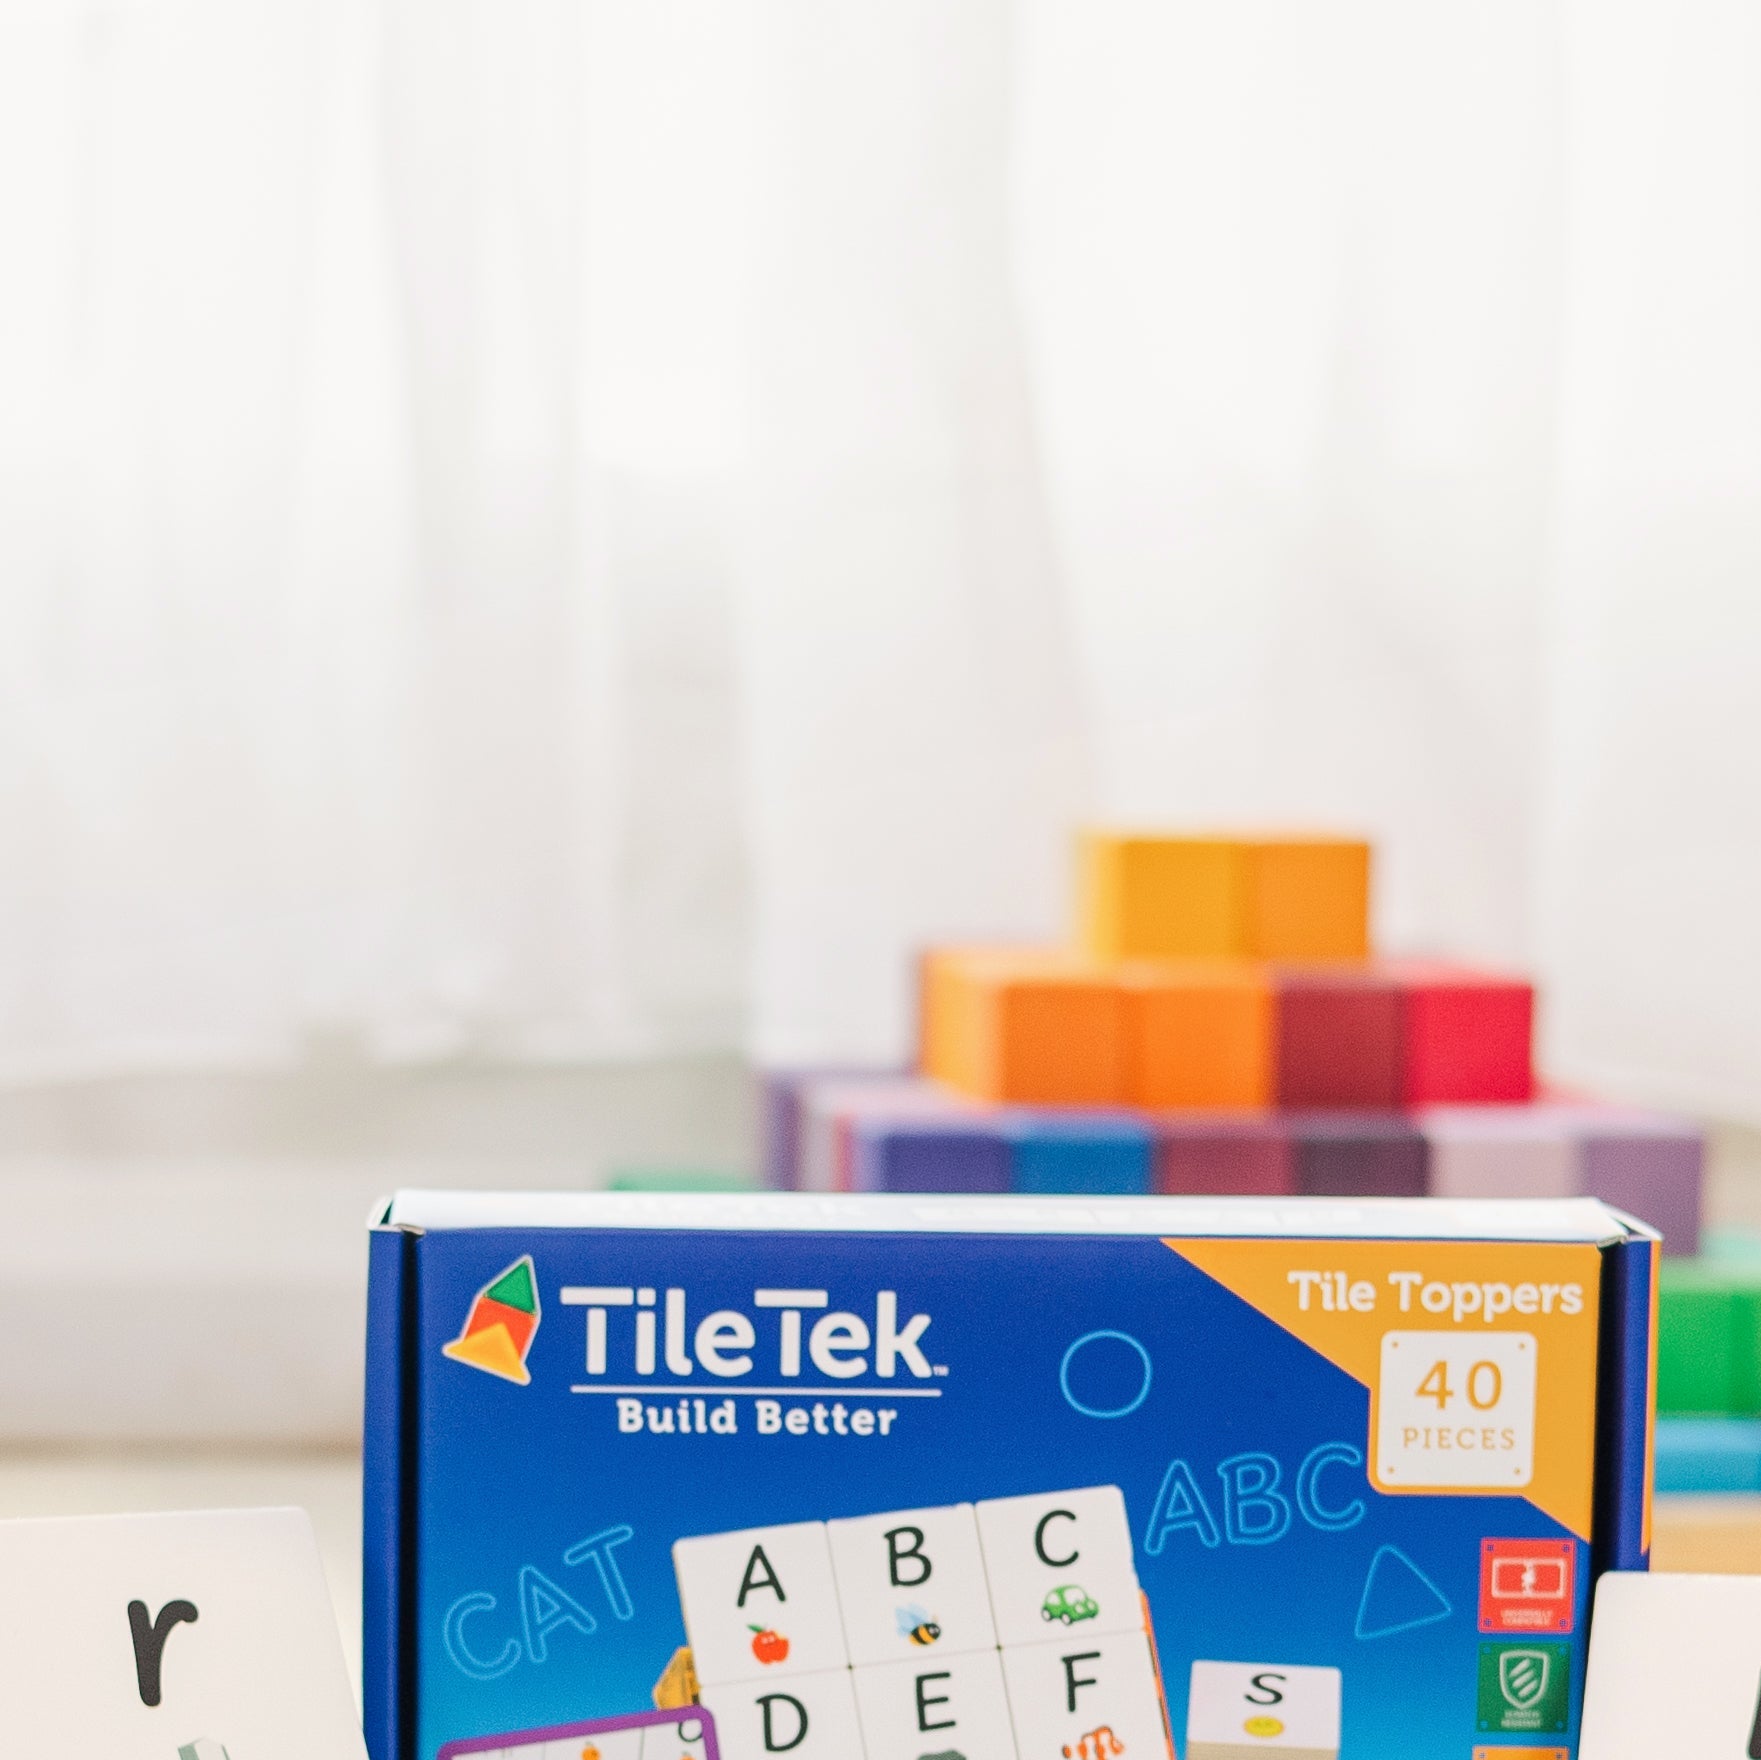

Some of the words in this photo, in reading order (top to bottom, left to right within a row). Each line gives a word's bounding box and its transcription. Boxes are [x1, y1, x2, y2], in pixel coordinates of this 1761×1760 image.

[1287, 1270, 1376, 1312] Tile
[1388, 1271, 1584, 1322] Toppers
[560, 1287, 933, 1378] TileTek
[617, 1398, 737, 1434] Build
[756, 1399, 897, 1436] Better
[1415, 1360, 1503, 1411] 40
[1402, 1427, 1515, 1451] PIECES
[1145, 1442, 1365, 1555] ABC
[736, 1544, 786, 1608] A
[883, 1526, 933, 1587] B
[1034, 1509, 1080, 1568] C
[444, 1525, 634, 1680] CAT
[755, 1693, 809, 1753] D
[915, 1671, 957, 1732] E
[1061, 1651, 1101, 1713] F
[1244, 1673, 1287, 1706] S
